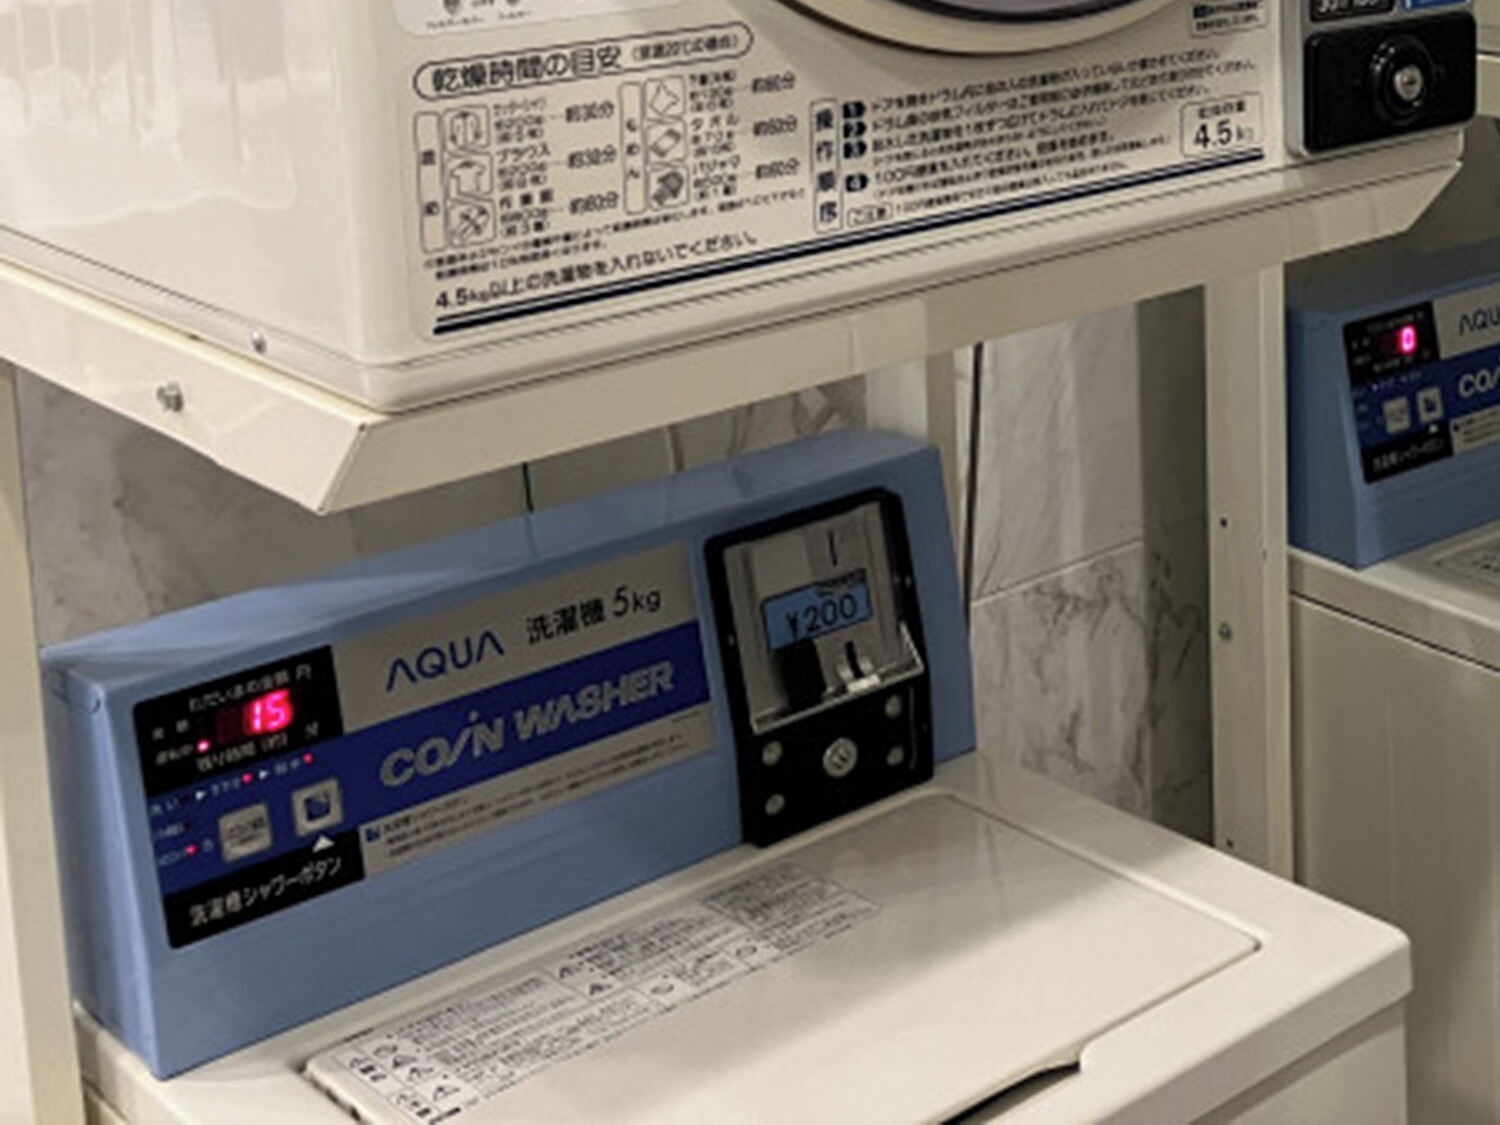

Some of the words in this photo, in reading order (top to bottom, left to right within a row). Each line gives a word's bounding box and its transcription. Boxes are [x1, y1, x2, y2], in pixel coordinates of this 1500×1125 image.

[432, 47, 622, 93] 乾燥時間の目安
[526, 598, 606, 645] 洗濯機
[613, 584, 662, 618] 5kg
[386, 630, 505, 693] AQUA
[251, 688, 290, 732] 15
[514, 660, 675, 741] WASHER
